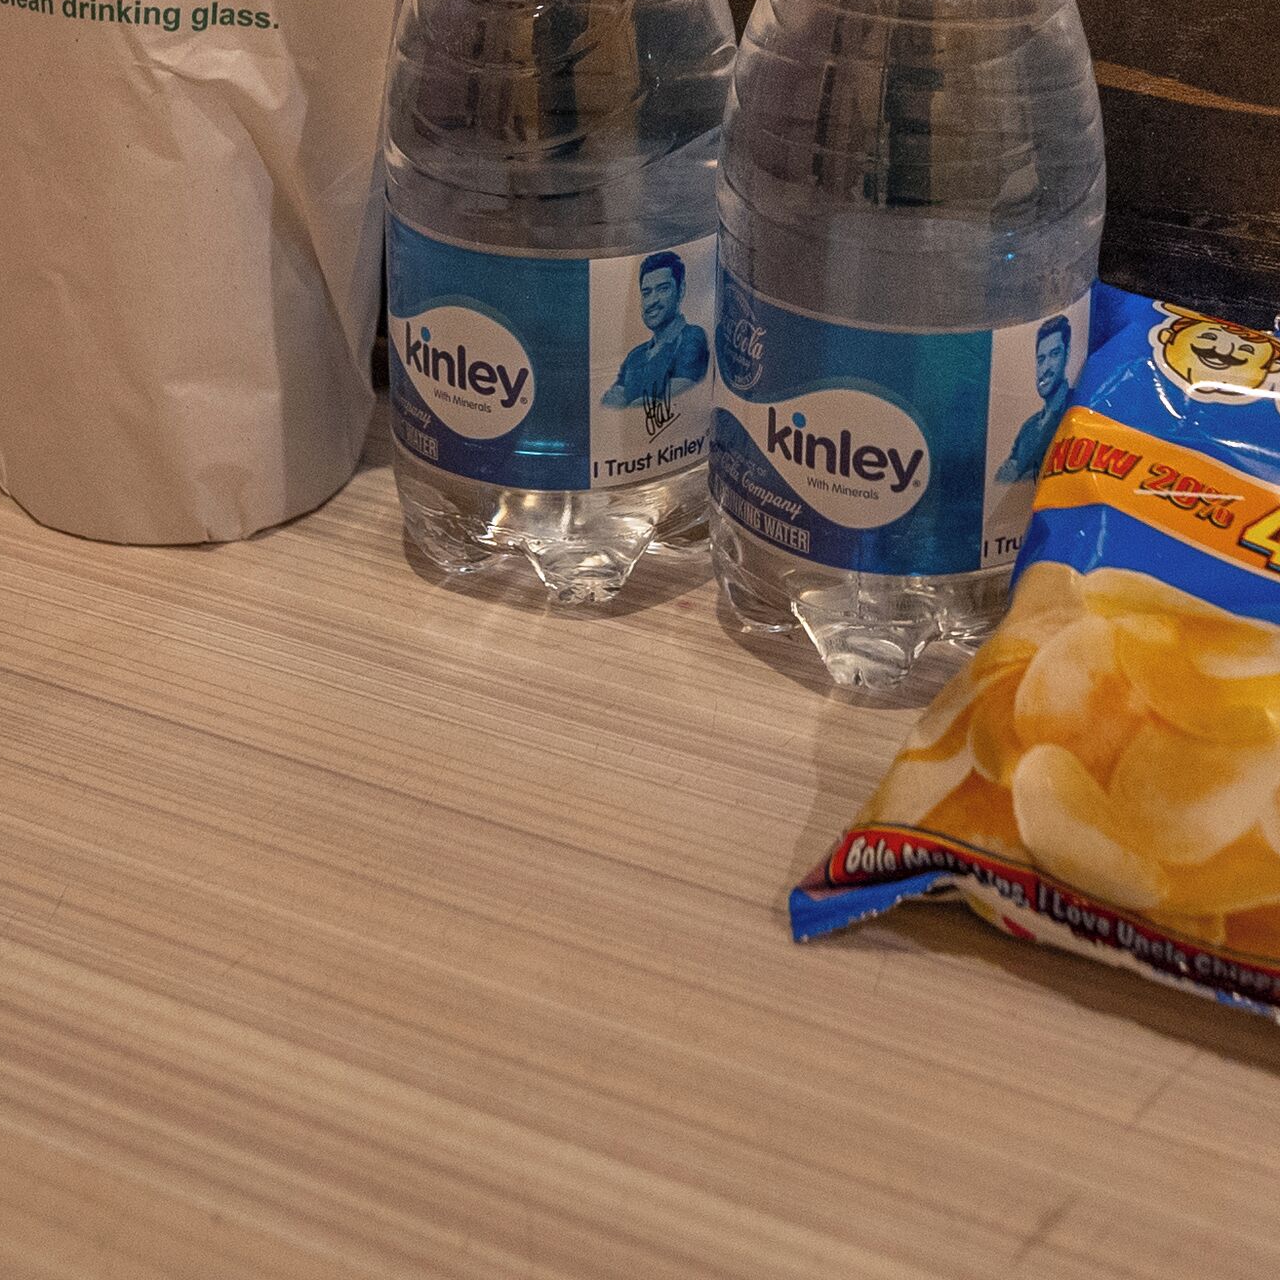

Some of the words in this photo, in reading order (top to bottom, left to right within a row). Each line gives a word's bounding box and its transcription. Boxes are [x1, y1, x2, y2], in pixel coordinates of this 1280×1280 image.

[191, 1, 280, 32] glass.
[405, 321, 529, 408] kinley
[433, 388, 452, 404] With
[452, 394, 492, 414] Minerals
[593, 461, 599, 479] I
[605, 452, 653, 476] Trust
[657, 436, 706, 465] Kinley
[767, 406, 924, 493] kinley
[742, 470, 803, 521] Company
[806, 476, 830, 491] With
[831, 483, 880, 500] Minerals
[1044, 435, 1143, 480] NOW
[1140, 462, 1235, 529] 20%
[764, 514, 807, 552] WATER
